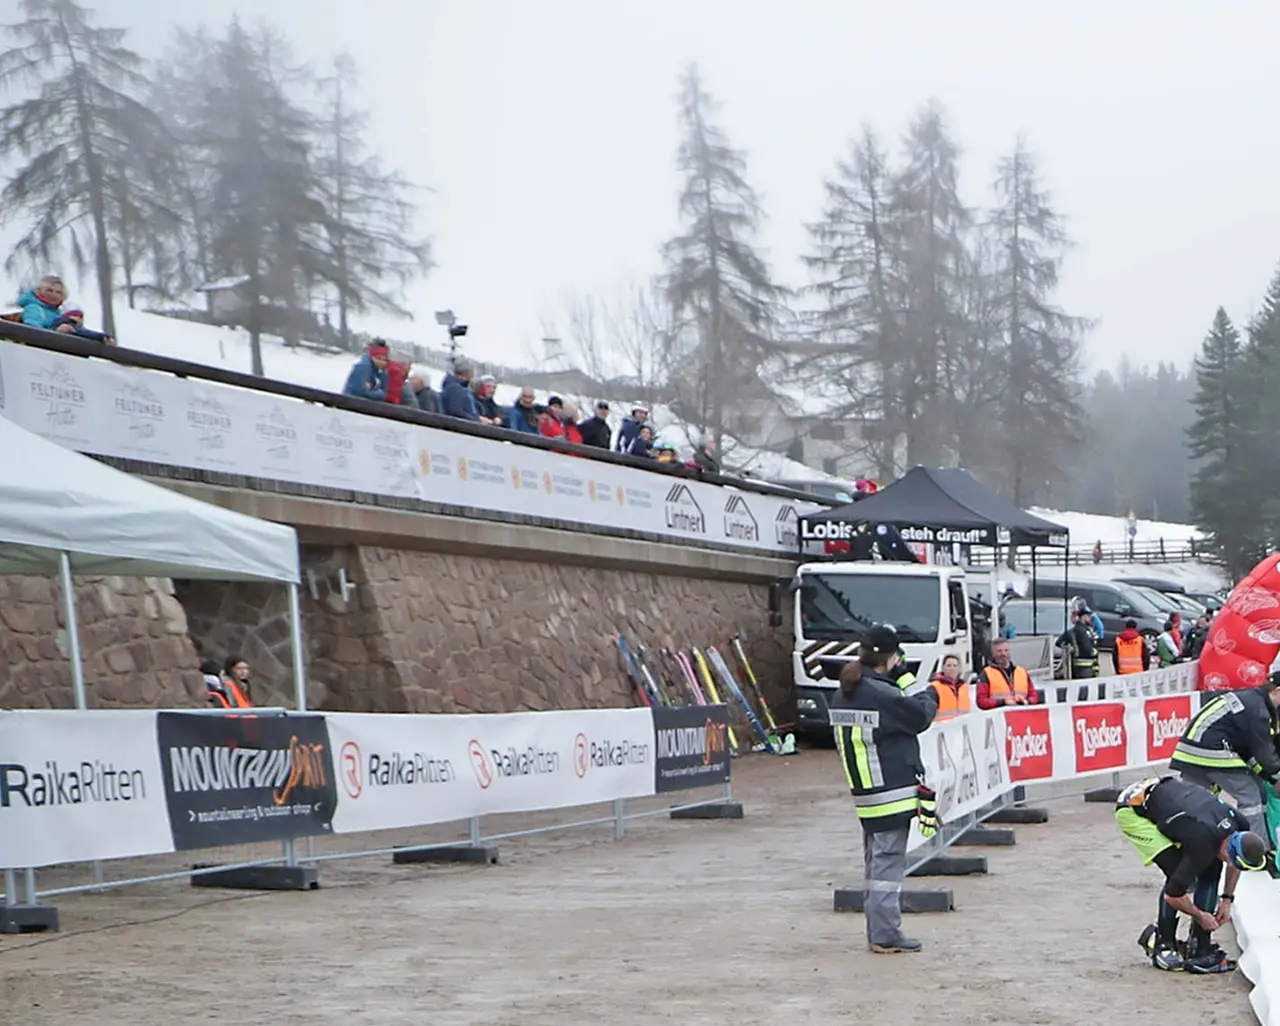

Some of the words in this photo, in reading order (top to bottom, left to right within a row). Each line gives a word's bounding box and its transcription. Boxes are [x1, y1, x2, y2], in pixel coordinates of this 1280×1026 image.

[901, 526, 934, 540] steh
[1076, 718, 1123, 758] Loacker
[0, 759, 146, 807] RaikaRitten
[368, 752, 455, 786] RaikaRitten
